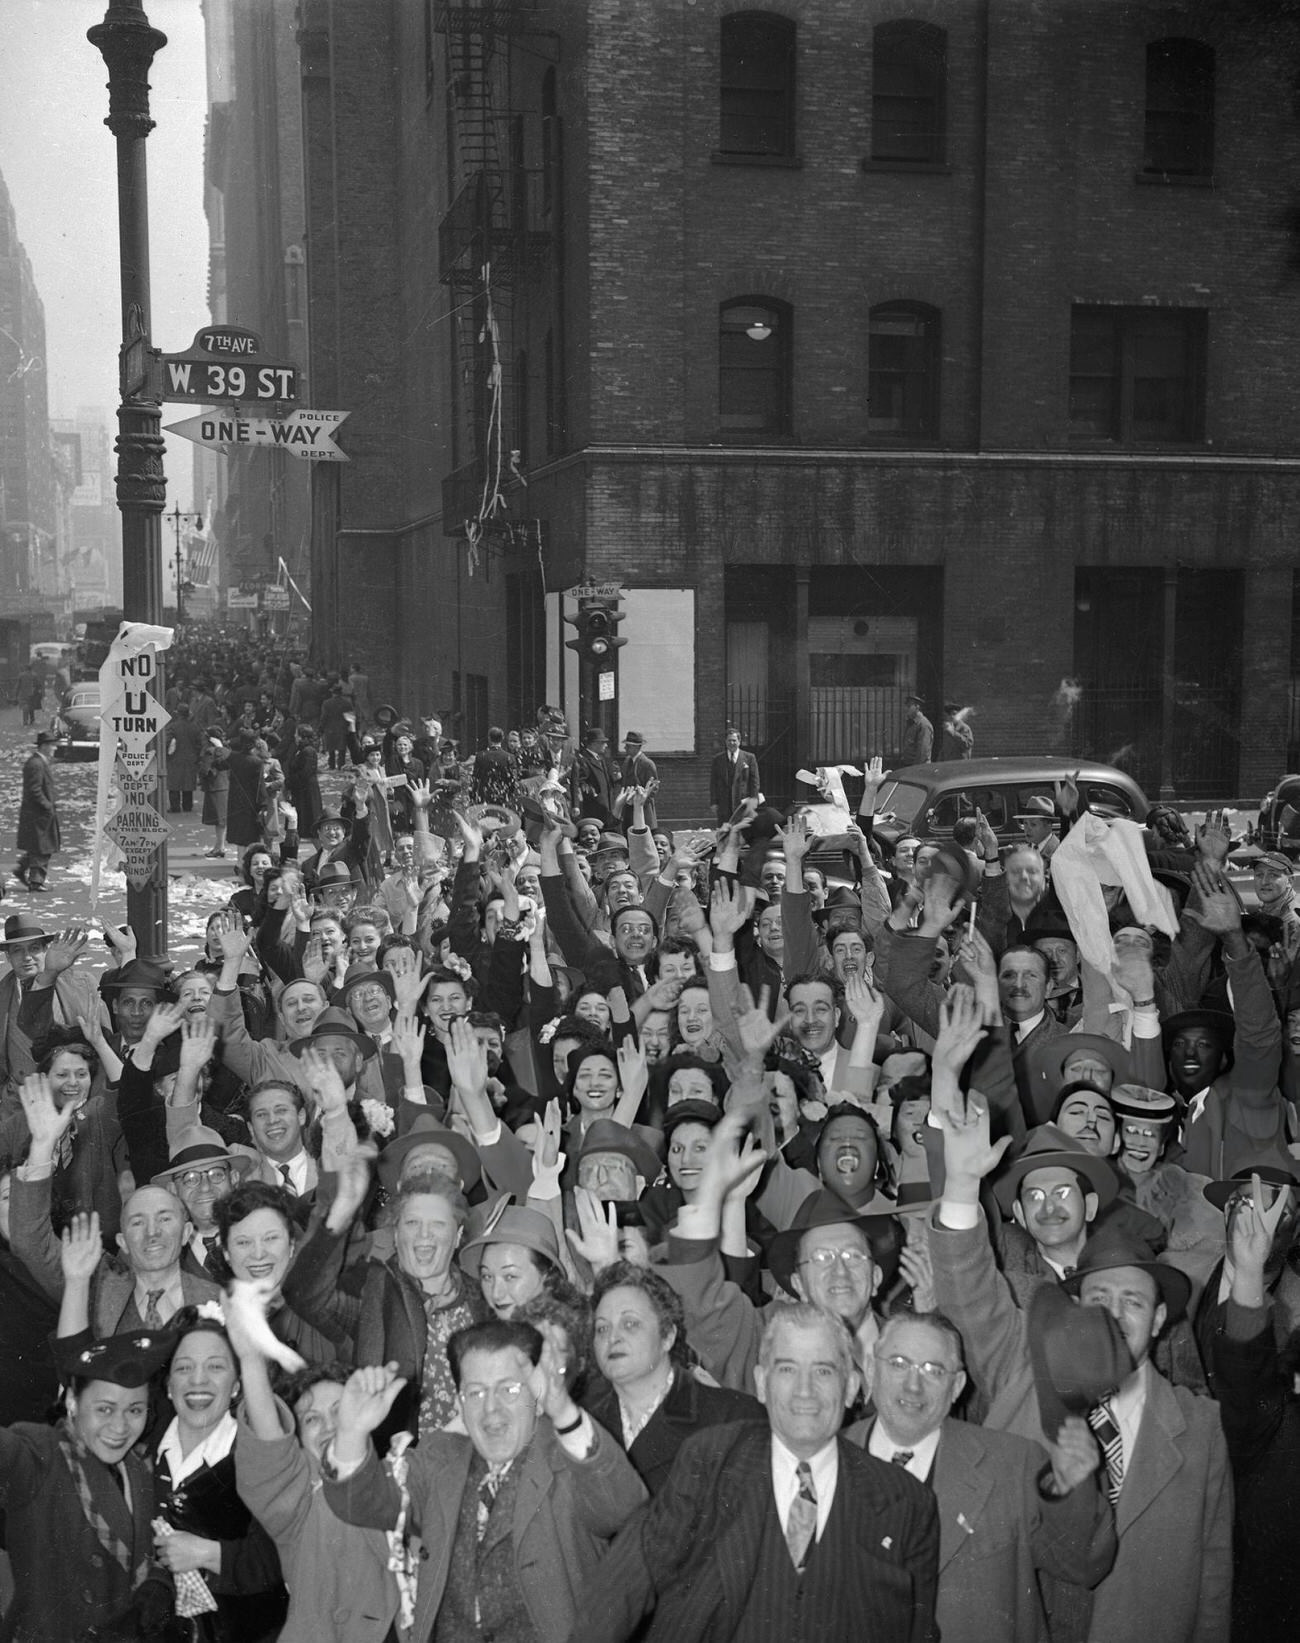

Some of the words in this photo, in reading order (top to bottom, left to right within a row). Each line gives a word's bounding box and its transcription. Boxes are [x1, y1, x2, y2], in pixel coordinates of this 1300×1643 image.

[204, 335, 231, 351] 7TH
[231, 338, 257, 354] AVE.
[168, 363, 196, 394] W.
[207, 365, 246, 397] 39
[257, 368, 295, 399] ST.
[299, 413, 340, 422] POLICE
[121, 654, 151, 676] NO
[126, 692, 146, 714] U
[112, 717, 157, 732] TURN
[130, 792, 145, 806] NO
[117, 812, 159, 827] PARKING
